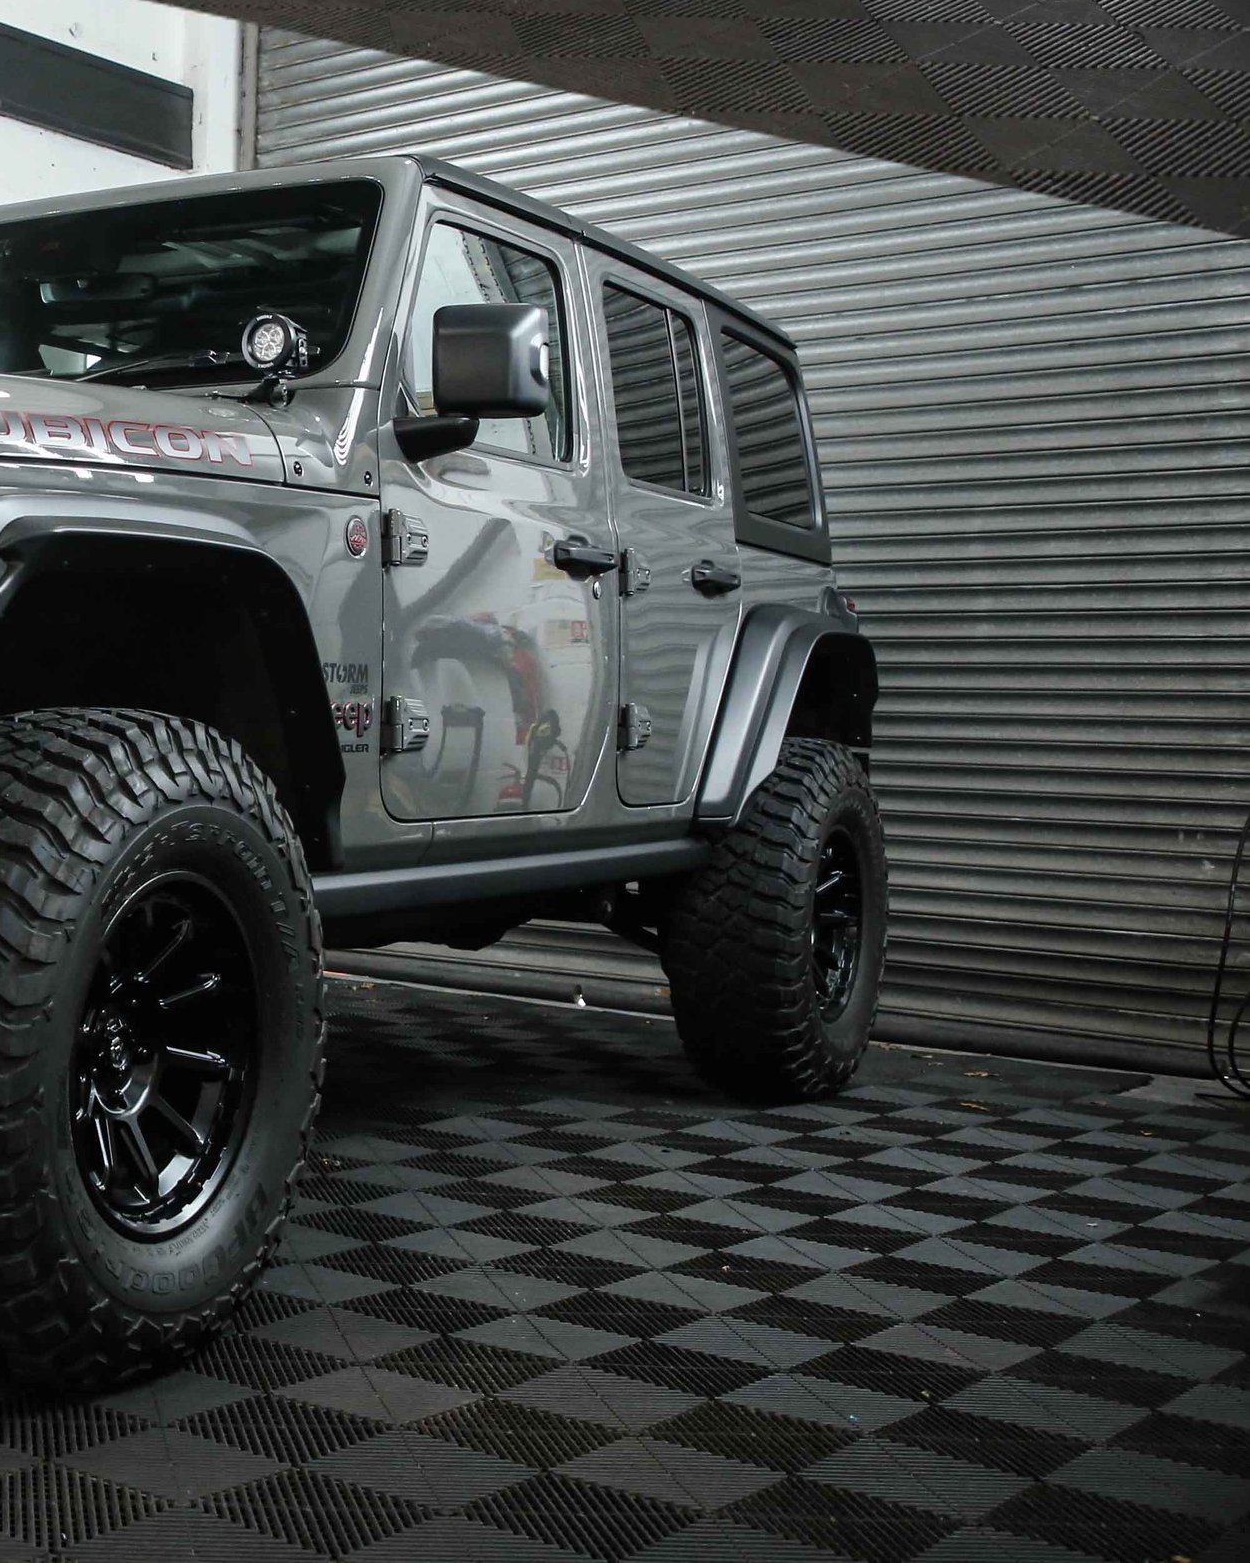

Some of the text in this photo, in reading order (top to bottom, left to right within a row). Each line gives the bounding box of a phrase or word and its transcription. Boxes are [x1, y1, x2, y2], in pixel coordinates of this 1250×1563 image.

[322, 662, 369, 684] STORM
[330, 701, 373, 738] eep
[341, 743, 369, 753] GLER
